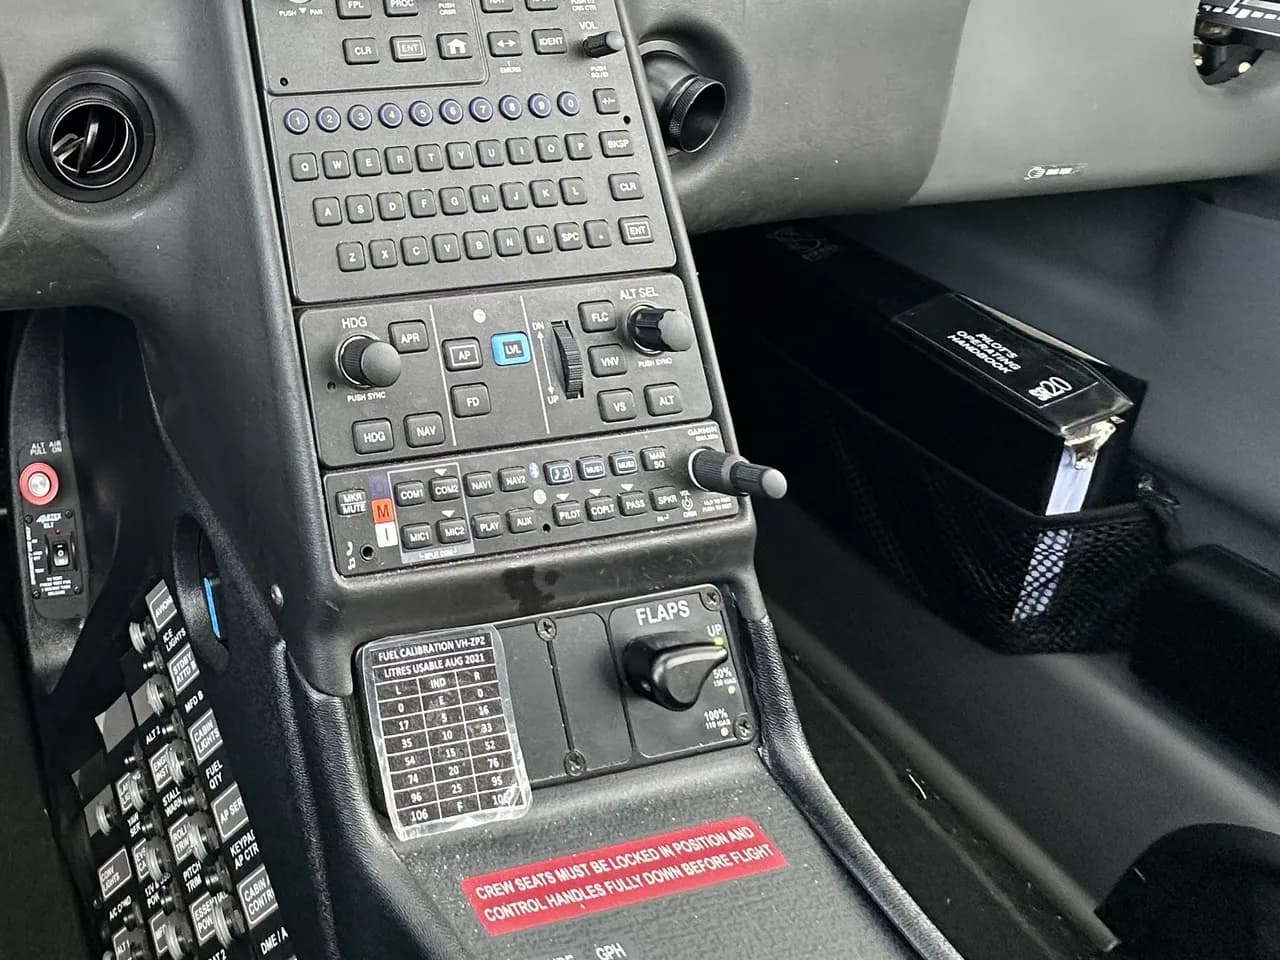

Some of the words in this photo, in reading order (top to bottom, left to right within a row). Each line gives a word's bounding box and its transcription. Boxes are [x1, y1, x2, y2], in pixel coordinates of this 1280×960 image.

[348, 0, 364, 10] FPL
[579, 22, 597, 31] VOL
[539, 37, 563, 46] IDENT
[355, 45, 371, 56] CLR
[621, 288, 637, 300] ALT
[639, 287, 658, 298] SEL
[592, 311, 608, 322] FLC
[342, 317, 367, 328] HDG
[401, 333, 419, 344] APR
[506, 345, 521, 356] LVL
[955, 330, 1021, 370] OPERATING
[976, 333, 1018, 359] PILOT'S
[458, 350, 471, 361] AP
[947, 334, 1012, 374] HANDBOOK
[601, 356, 619, 366] VNV
[467, 397, 479, 407] FD
[364, 431, 385, 442] HDG
[417, 426, 436, 437] NAV
[472, 482, 491, 490] NAV1
[506, 476, 525, 485] NAV2
[401, 492, 423, 500] COM1
[435, 486, 458, 495] COM2
[343, 494, 362, 502] MKR
[343, 504, 366, 513] MUTE
[626, 501, 645, 509] PASS
[560, 510, 580, 519] PILOT
[517, 518, 532, 526] AUX
[410, 533, 429, 541] MIC1
[445, 528, 464, 536] MIC2
[636, 601, 690, 625] FLAPS
[707, 624, 721, 636] UP
[163, 629, 172, 643] ICE
[166, 628, 186, 652] LIGHTS
[378, 649, 399, 661] FUEL
[400, 641, 455, 657] CALIBRATION
[455, 636, 485, 648] VH-ZPZ
[173, 651, 192, 674] STDBY
[384, 667, 412, 678] LITRES
[414, 662, 443, 673] USABLE
[444, 656, 463, 667] AUG
[465, 653, 485, 664] 2021
[713, 668, 732, 678] 50%
[704, 708, 728, 720] 100%
[194, 720, 213, 741] CABIN
[197, 728, 220, 753] LIGHTS
[405, 756, 415, 766] 54
[446, 749, 456, 758] 15
[485, 741, 495, 750] 52
[206, 760, 223, 779] FUEL
[162, 787, 180, 806] STALL
[476, 882, 515, 899] CREW
[518, 872, 555, 890] SEATS
[556, 865, 590, 882] MUST
[593, 860, 610, 873] BE
[611, 848, 657, 870] LOCKED
[659, 846, 672, 857] IN
[675, 834, 727, 854] POSITION
[730, 827, 754, 840] AND
[183, 861, 201, 881] PITCH
[485, 899, 547, 921] CONTROL
[547, 887, 606, 909] HANDLES
[607, 877, 644, 895] FULLY
[644, 866, 681, 886] DOWN
[683, 856, 730, 876] BEFORE
[731, 844, 773, 864] FLIGHT
[596, 943, 626, 960] GPH
